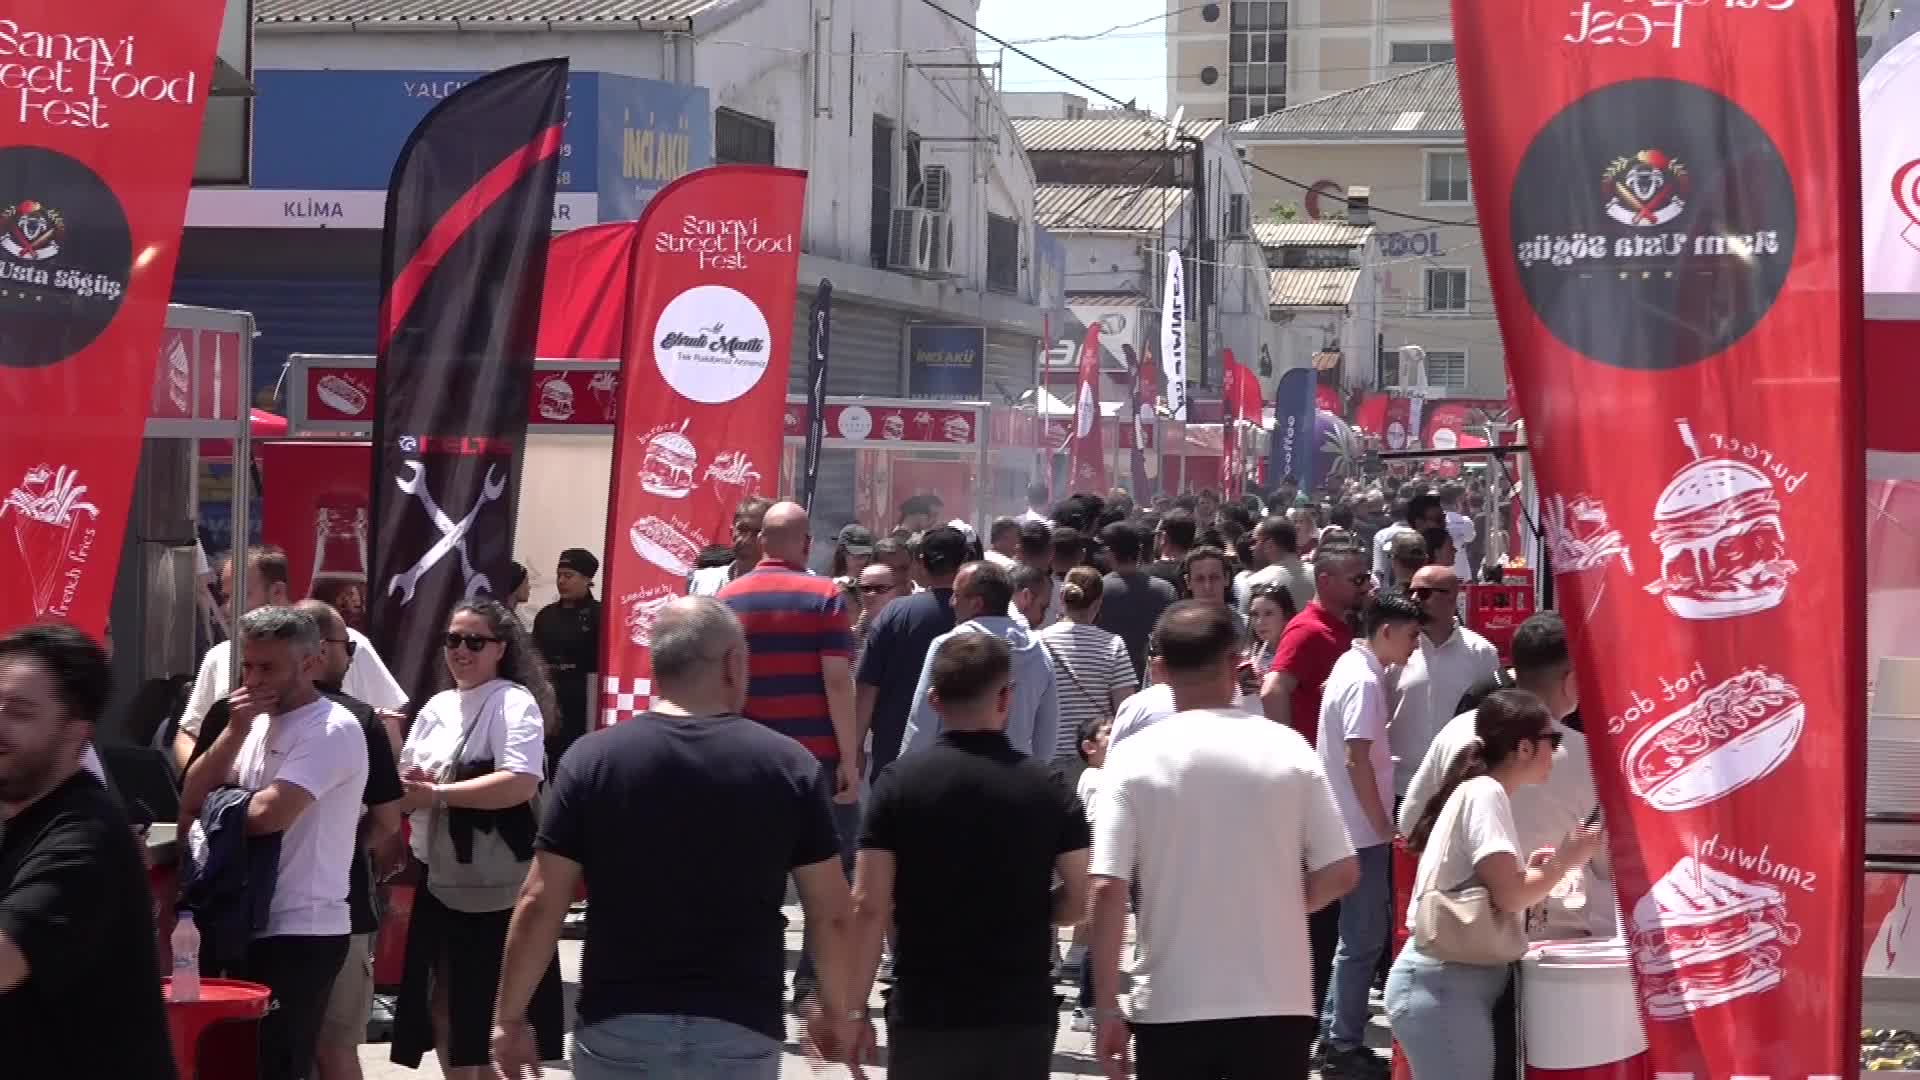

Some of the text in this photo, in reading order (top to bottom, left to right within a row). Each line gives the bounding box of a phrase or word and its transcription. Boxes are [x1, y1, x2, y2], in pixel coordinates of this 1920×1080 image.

[88, 62, 195, 104] Food
[19, 87, 110, 128] Fest
[283, 198, 344, 218] KLİMA
[682, 215, 758, 238] Sanayi
[655, 232, 793, 253] Street Food
[699, 251, 749, 270] Fest
[50, 527, 97, 617] french fries
